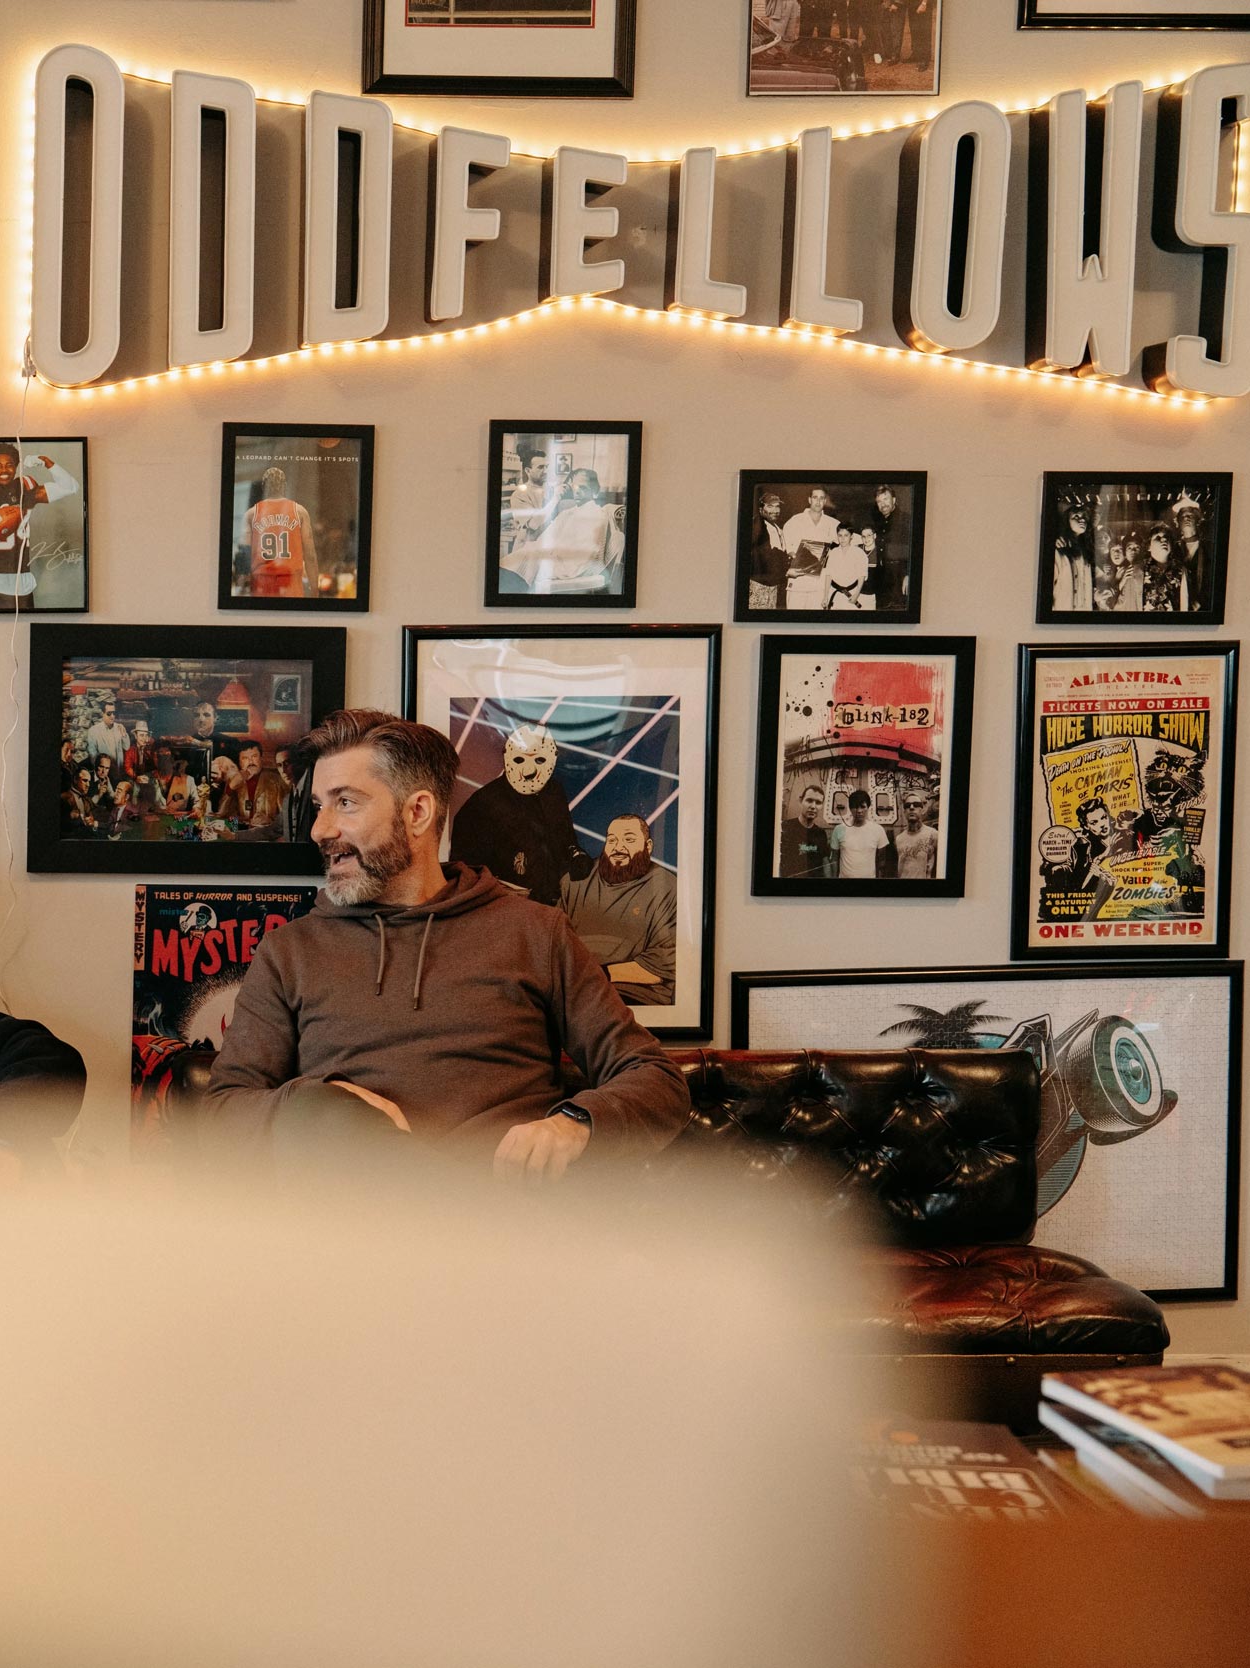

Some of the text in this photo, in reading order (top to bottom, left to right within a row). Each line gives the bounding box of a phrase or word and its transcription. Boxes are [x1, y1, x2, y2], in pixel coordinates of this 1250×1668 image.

[31, 43, 1250, 398] ODDFELLOWS
[261, 531, 291, 560] 91
[1070, 671, 1182, 688] ALHAMBRA
[1049, 699, 1203, 711] TICKETS NOW ON SALE
[1046, 712, 1205, 750] HUGE HORROR SHOW
[1071, 756, 1082, 768] ON
[1084, 751, 1097, 763] THE
[1075, 766, 1123, 790] CATMAN
[1078, 790, 1089, 800] OF
[1112, 793, 1130, 801] WHAT
[154, 892, 302, 902] TALES OF HORROR AND SUSPENSE!
[1112, 886, 1176, 900] ZOMBIES
[1051, 906, 1090, 915] ONLY!
[135, 891, 146, 963] MYSTERY
[1039, 922, 1203, 938] ONE WEEKEND
